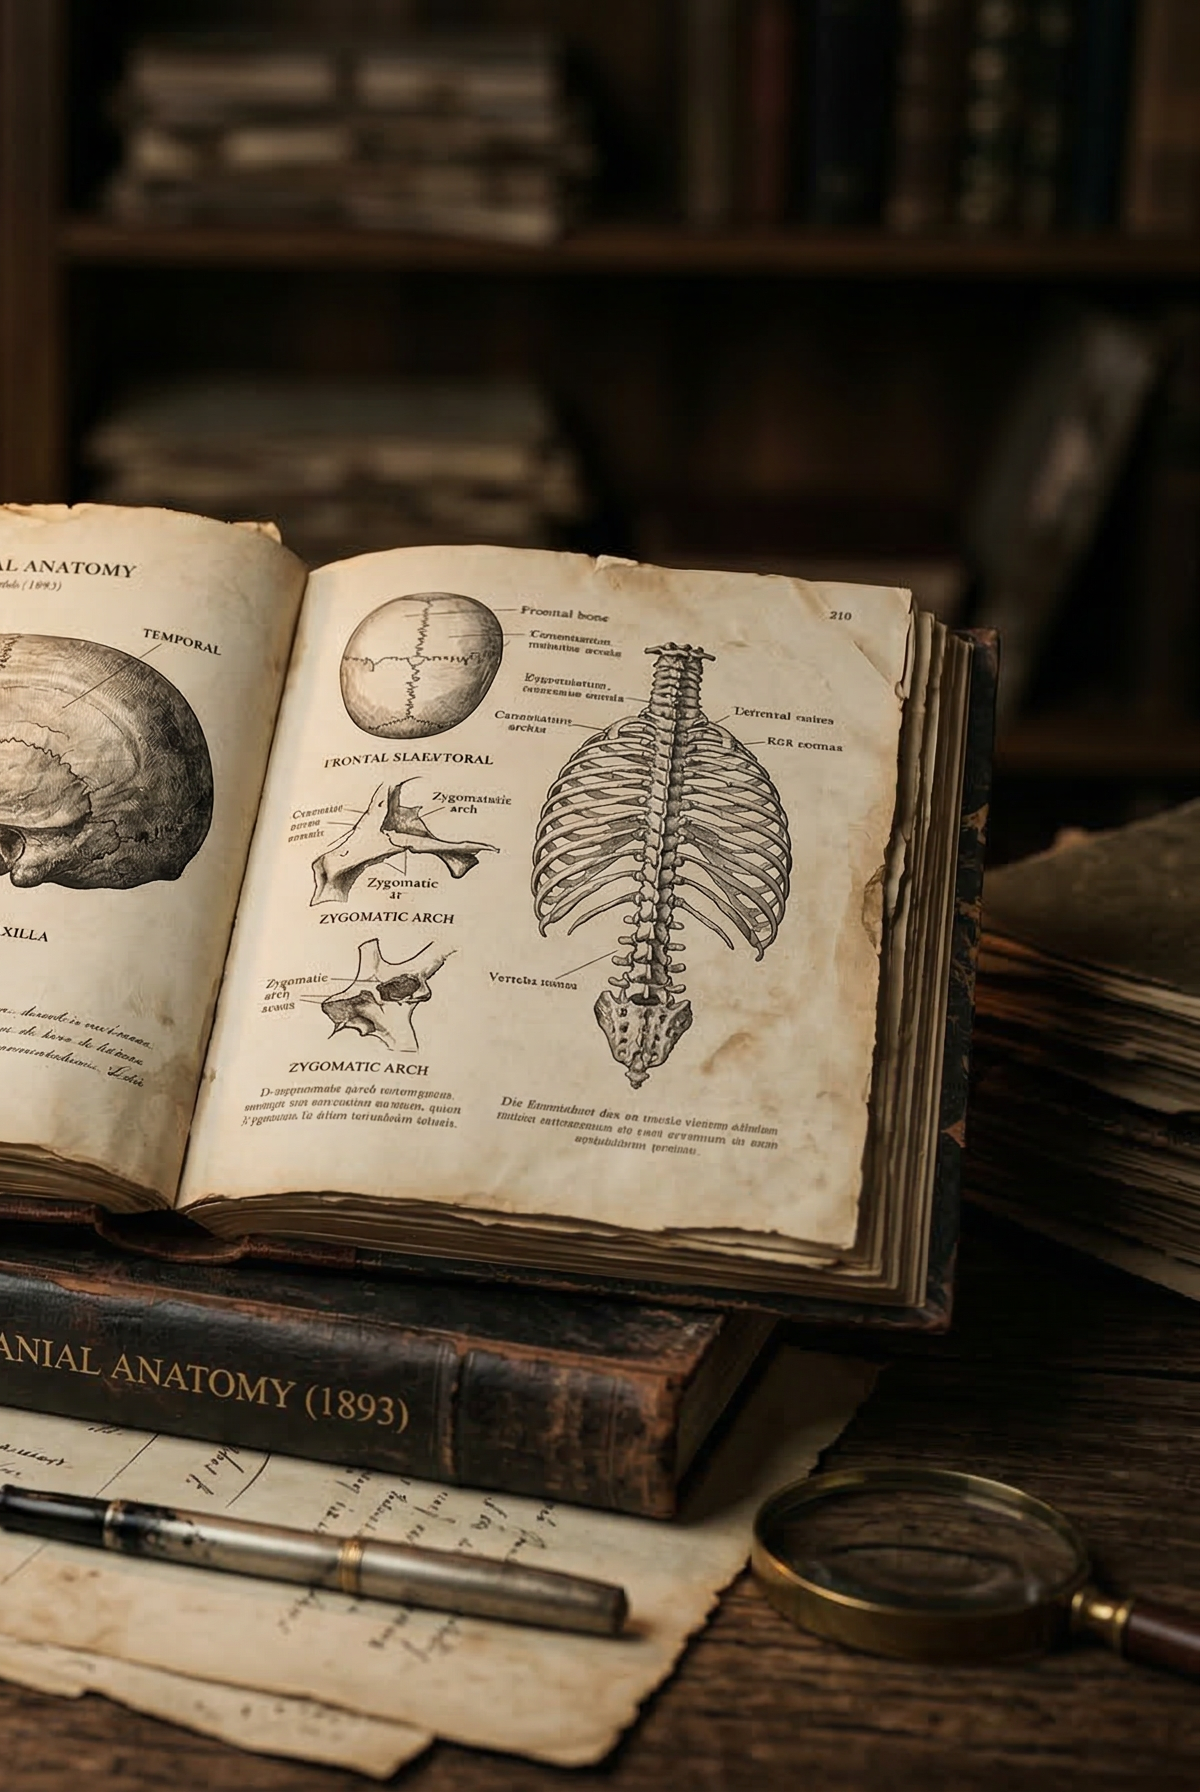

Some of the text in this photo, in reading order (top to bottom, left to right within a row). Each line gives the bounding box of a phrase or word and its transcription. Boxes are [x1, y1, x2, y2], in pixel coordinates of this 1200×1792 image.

[23, 560, 137, 579] ANATOMY
[829, 611, 852, 621] 210
[142, 628, 222, 656] TEMPORAL
[450, 805, 478, 815] arch
[367, 877, 439, 891] Zygomatic
[319, 911, 455, 925] ZYGOMATIC ARCH
[288, 1061, 429, 1076] ZYGOMATIC ARCH
[110, 1354, 296, 1410] ANATOMY
[304, 1388, 410, 1434] (1893)
